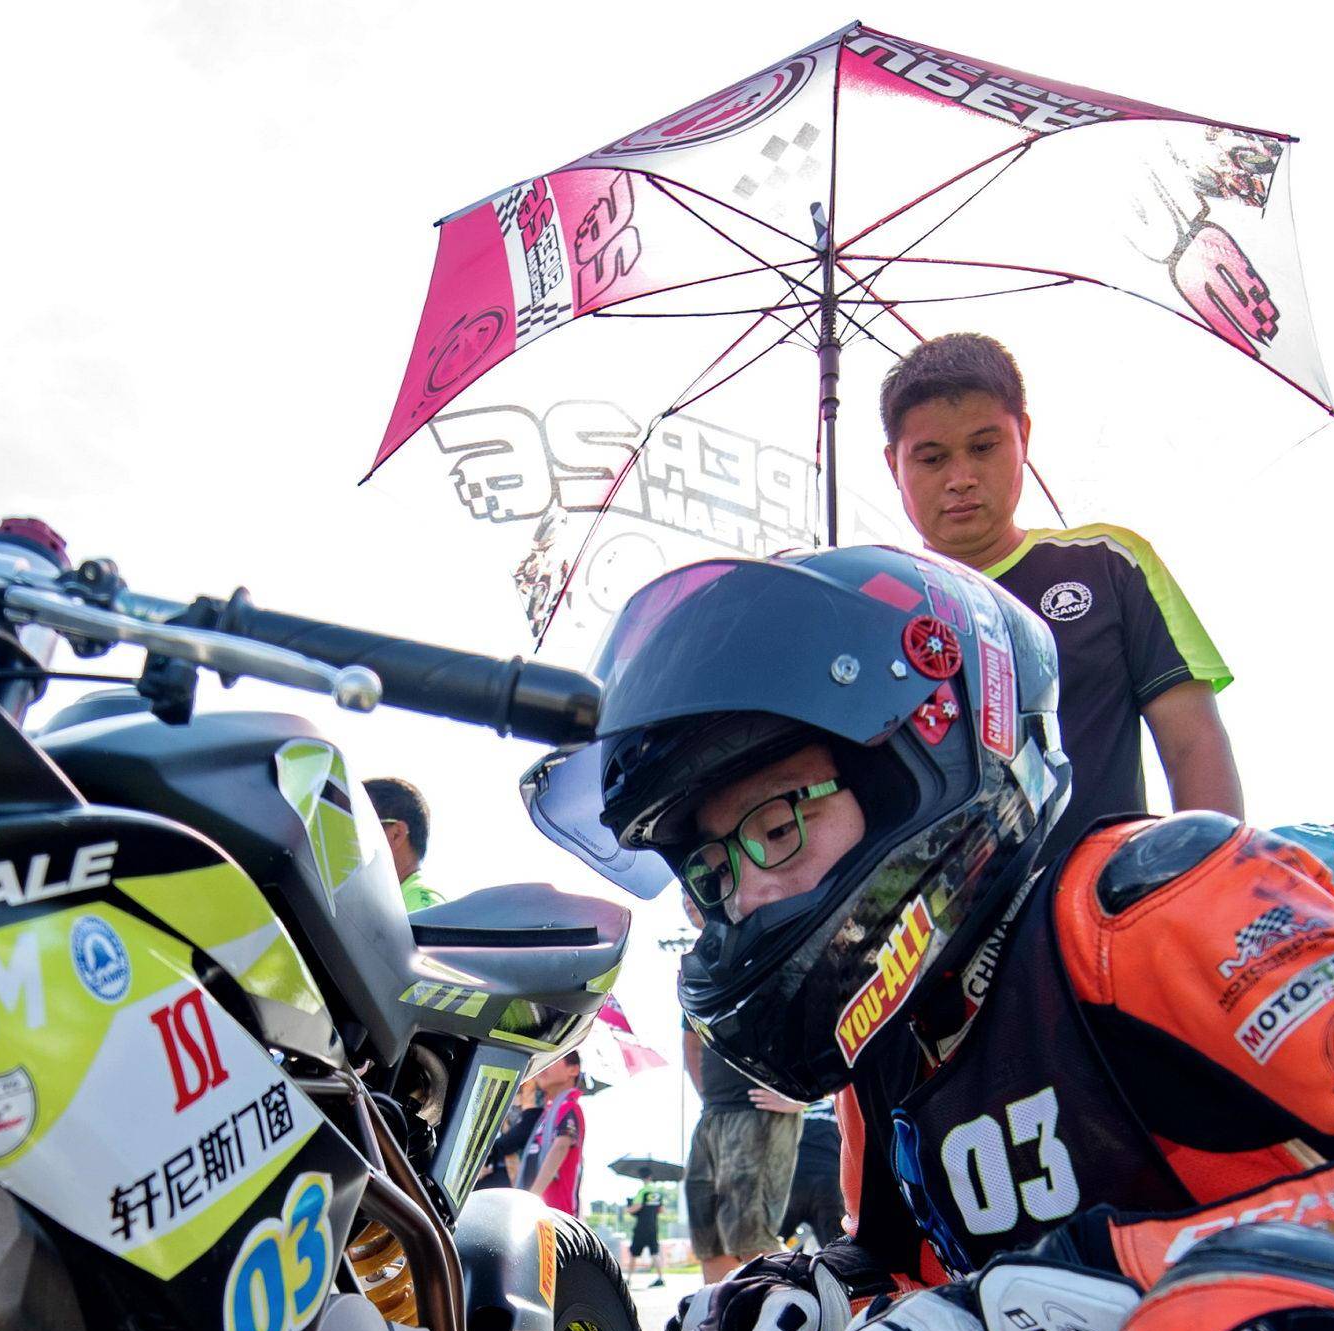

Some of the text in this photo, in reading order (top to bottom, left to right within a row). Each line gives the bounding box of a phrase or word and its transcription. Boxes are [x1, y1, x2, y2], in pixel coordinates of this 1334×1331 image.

[986, 649, 1002, 744] GUANGZHOU
[838, 910, 931, 1051] YOU-ALL
[110, 1080, 294, 1241] 轩尼斯门窗
[940, 1086, 1079, 1236] 03
